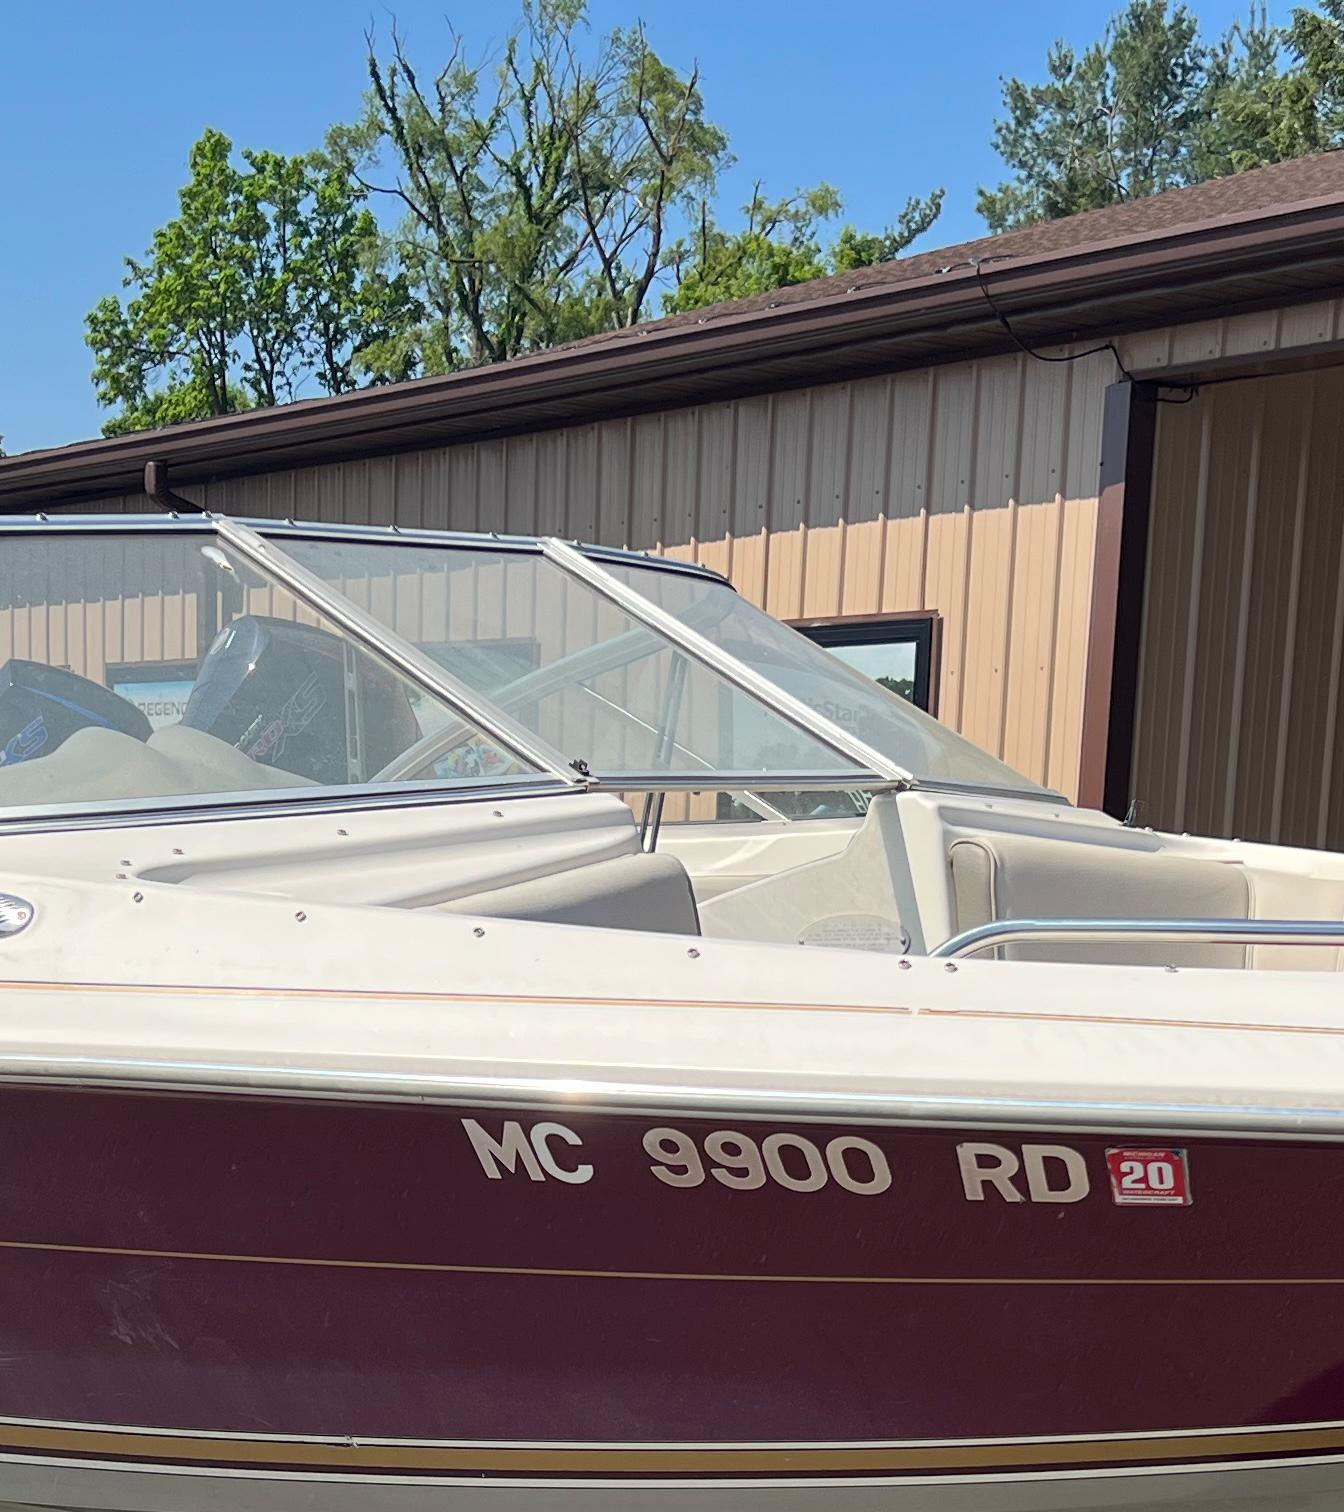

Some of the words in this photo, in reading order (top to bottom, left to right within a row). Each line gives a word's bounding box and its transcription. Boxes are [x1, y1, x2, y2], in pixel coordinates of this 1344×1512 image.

[460, 1118, 594, 1184] MC
[642, 1127, 892, 1195] 9900
[956, 1142, 1090, 1203] RD
[1119, 1160, 1175, 1190] 20
